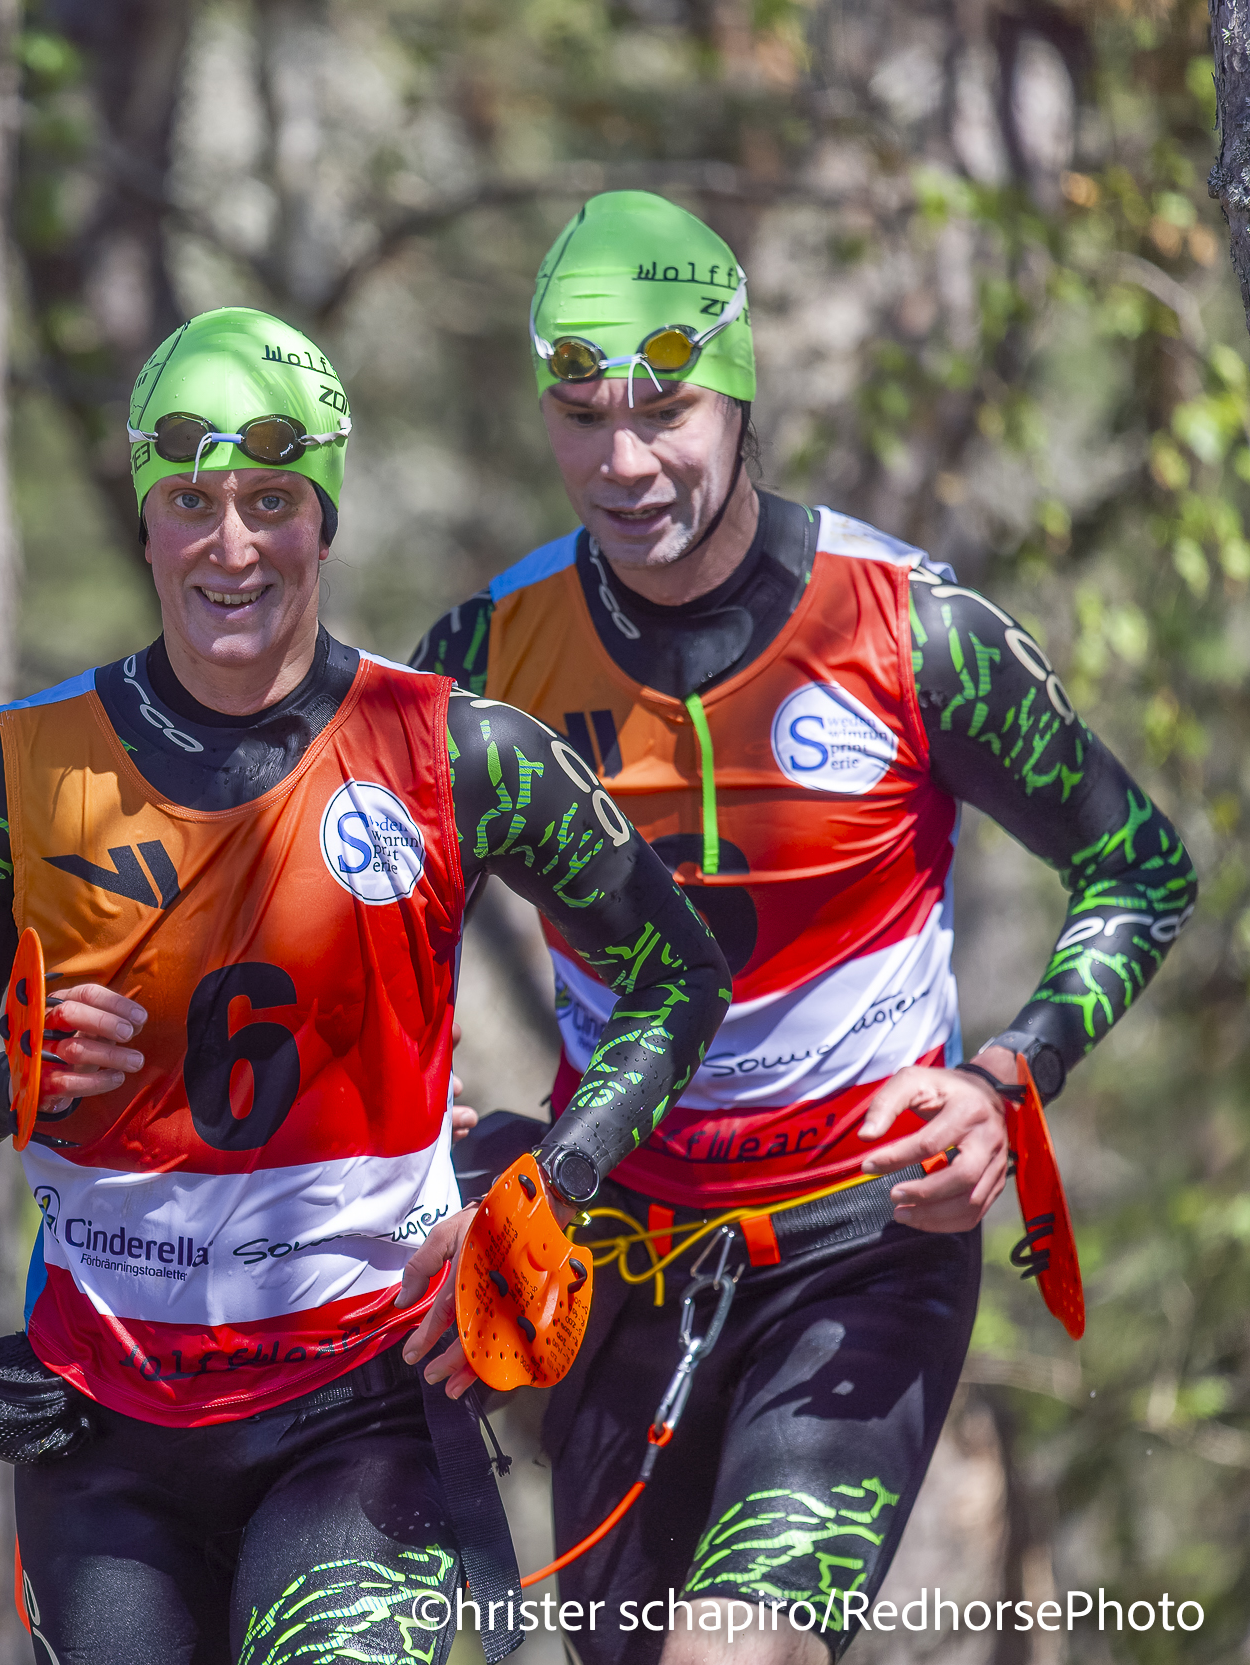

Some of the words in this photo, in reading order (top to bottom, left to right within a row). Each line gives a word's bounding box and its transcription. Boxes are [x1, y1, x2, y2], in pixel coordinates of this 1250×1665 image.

[372, 860, 398, 875] erie
[183, 961, 301, 1152] 6
[65, 1218, 209, 1267] Cinderella
